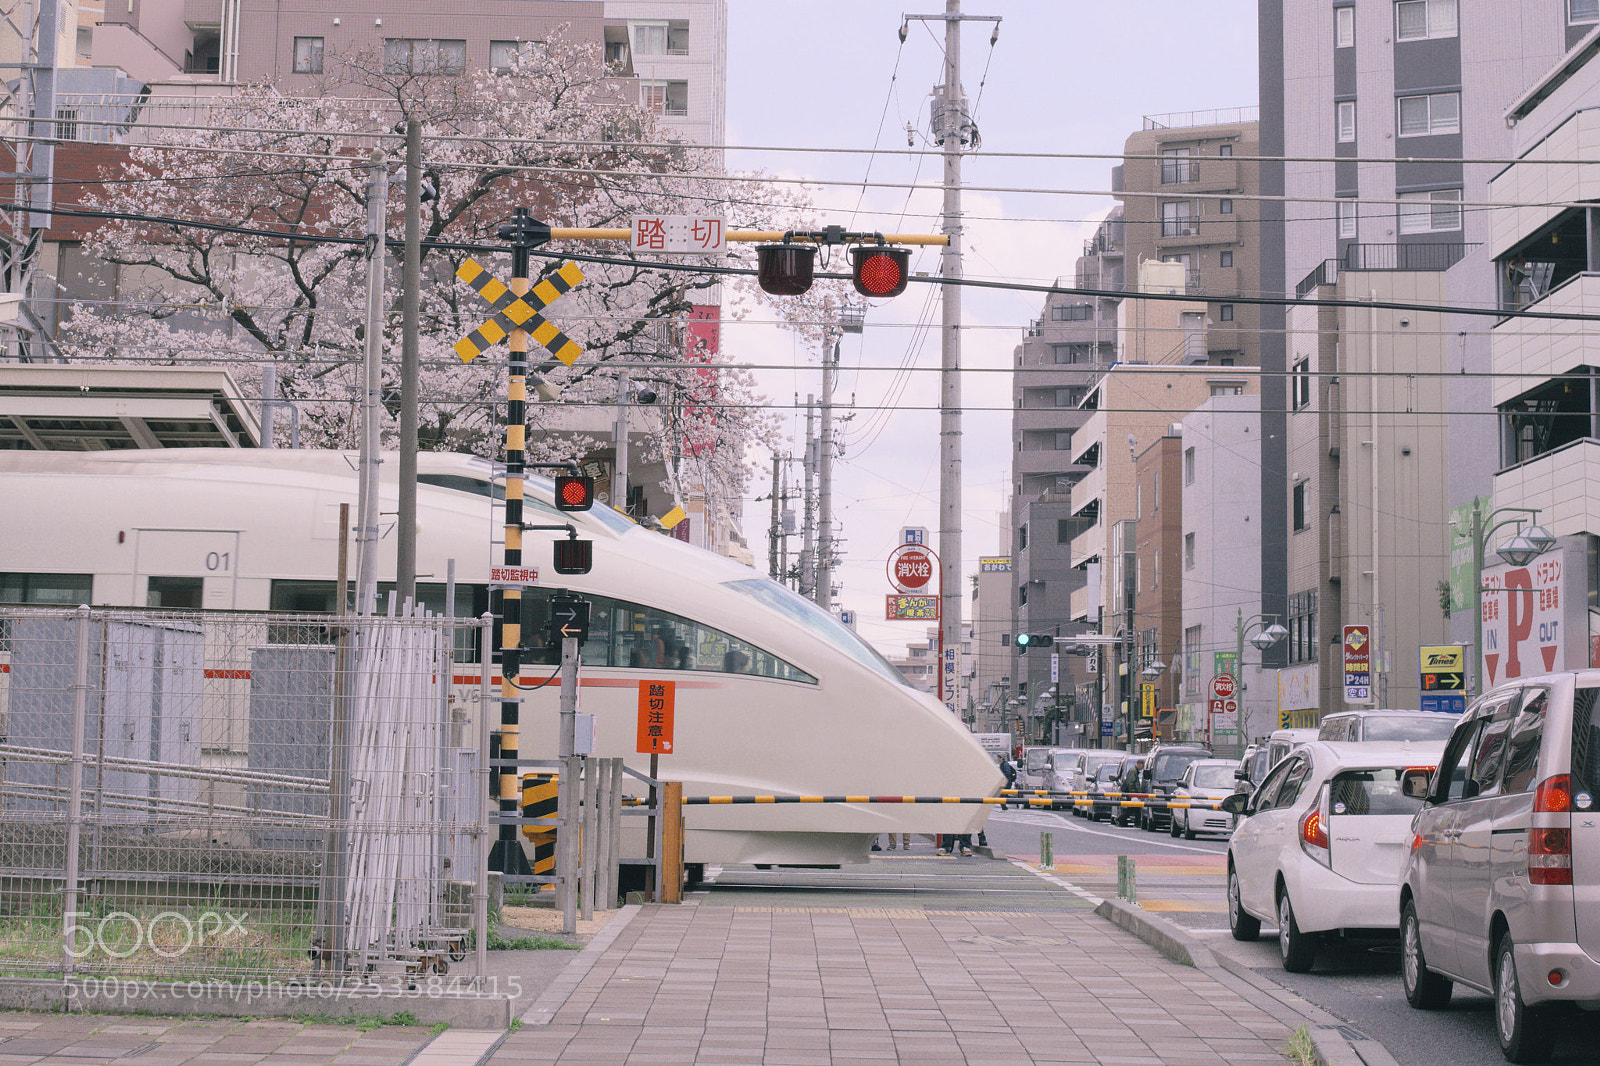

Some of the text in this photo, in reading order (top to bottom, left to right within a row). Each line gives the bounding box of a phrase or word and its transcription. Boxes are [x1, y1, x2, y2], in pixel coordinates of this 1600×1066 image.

[636, 218, 721, 249] 踏切
[206, 552, 229, 571] 01
[898, 562, 929, 577] 消火栓
[491, 569, 538, 581] 踏切監視中
[1537, 560, 1561, 585] ドラゴン
[897, 598, 927, 609] まんが
[1505, 568, 1533, 678] P
[1540, 621, 1558, 642] OUT
[1487, 629, 1497, 650] IN
[1425, 675, 1436, 689] P
[1348, 688, 1367, 698] 空車
